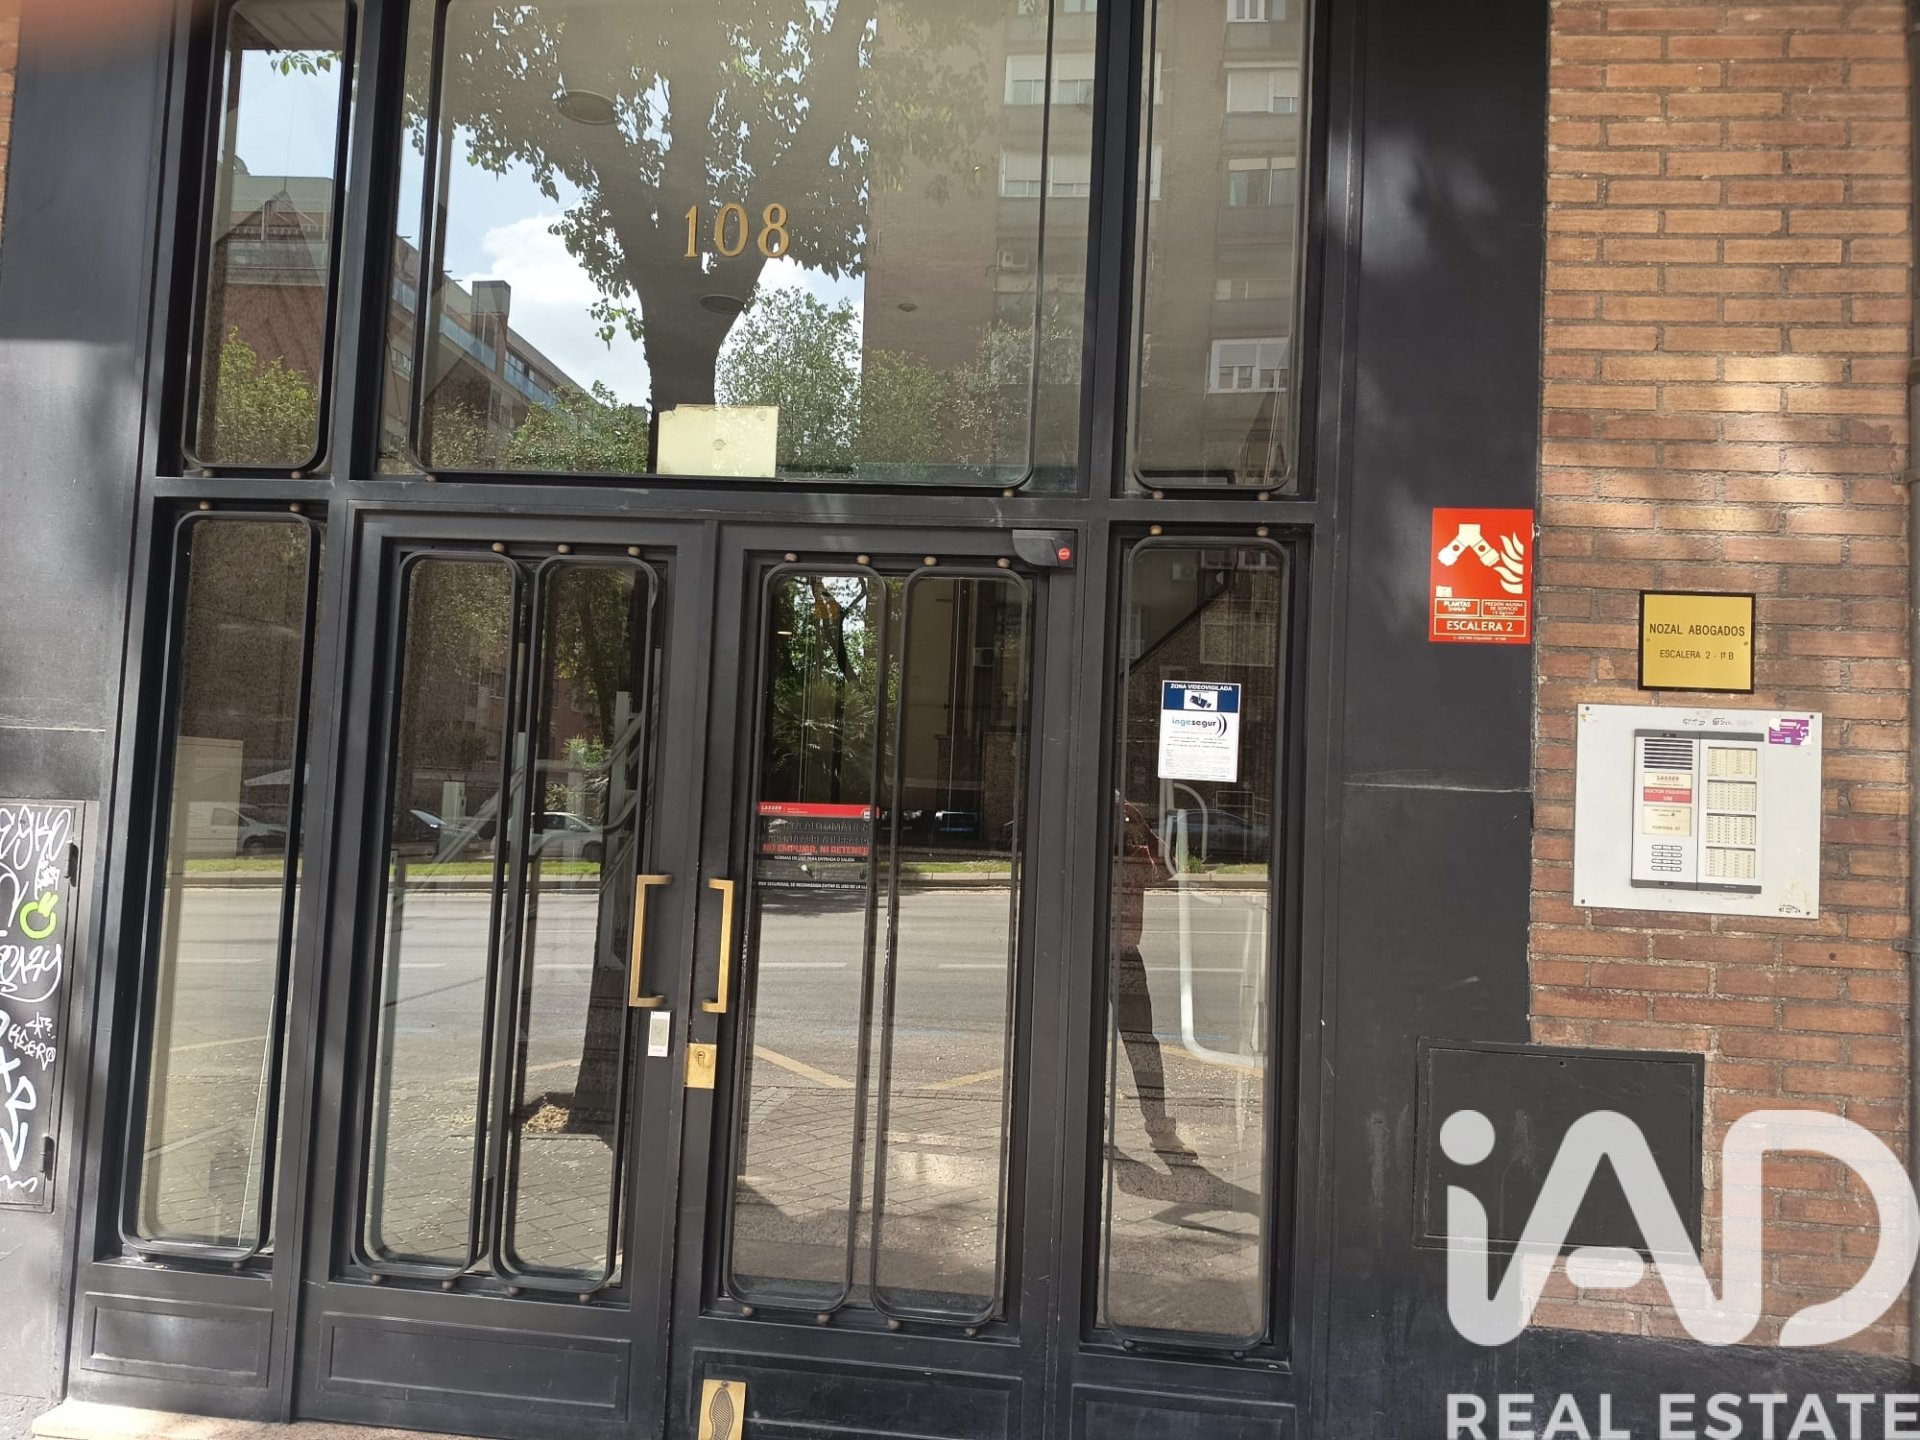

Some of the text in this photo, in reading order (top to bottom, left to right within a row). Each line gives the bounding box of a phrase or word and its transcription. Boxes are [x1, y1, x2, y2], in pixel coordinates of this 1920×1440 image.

[684, 202, 789, 259] 108
[1446, 620, 1513, 632] ESCALERA 2
[1649, 624, 1745, 636] NOZAL ABOGADOS
[1660, 650, 1700, 659] ESCALERA
[1728, 652, 1734, 660] B
[1172, 717, 1216, 728] ingesegur
[763, 844, 776, 852] NO
